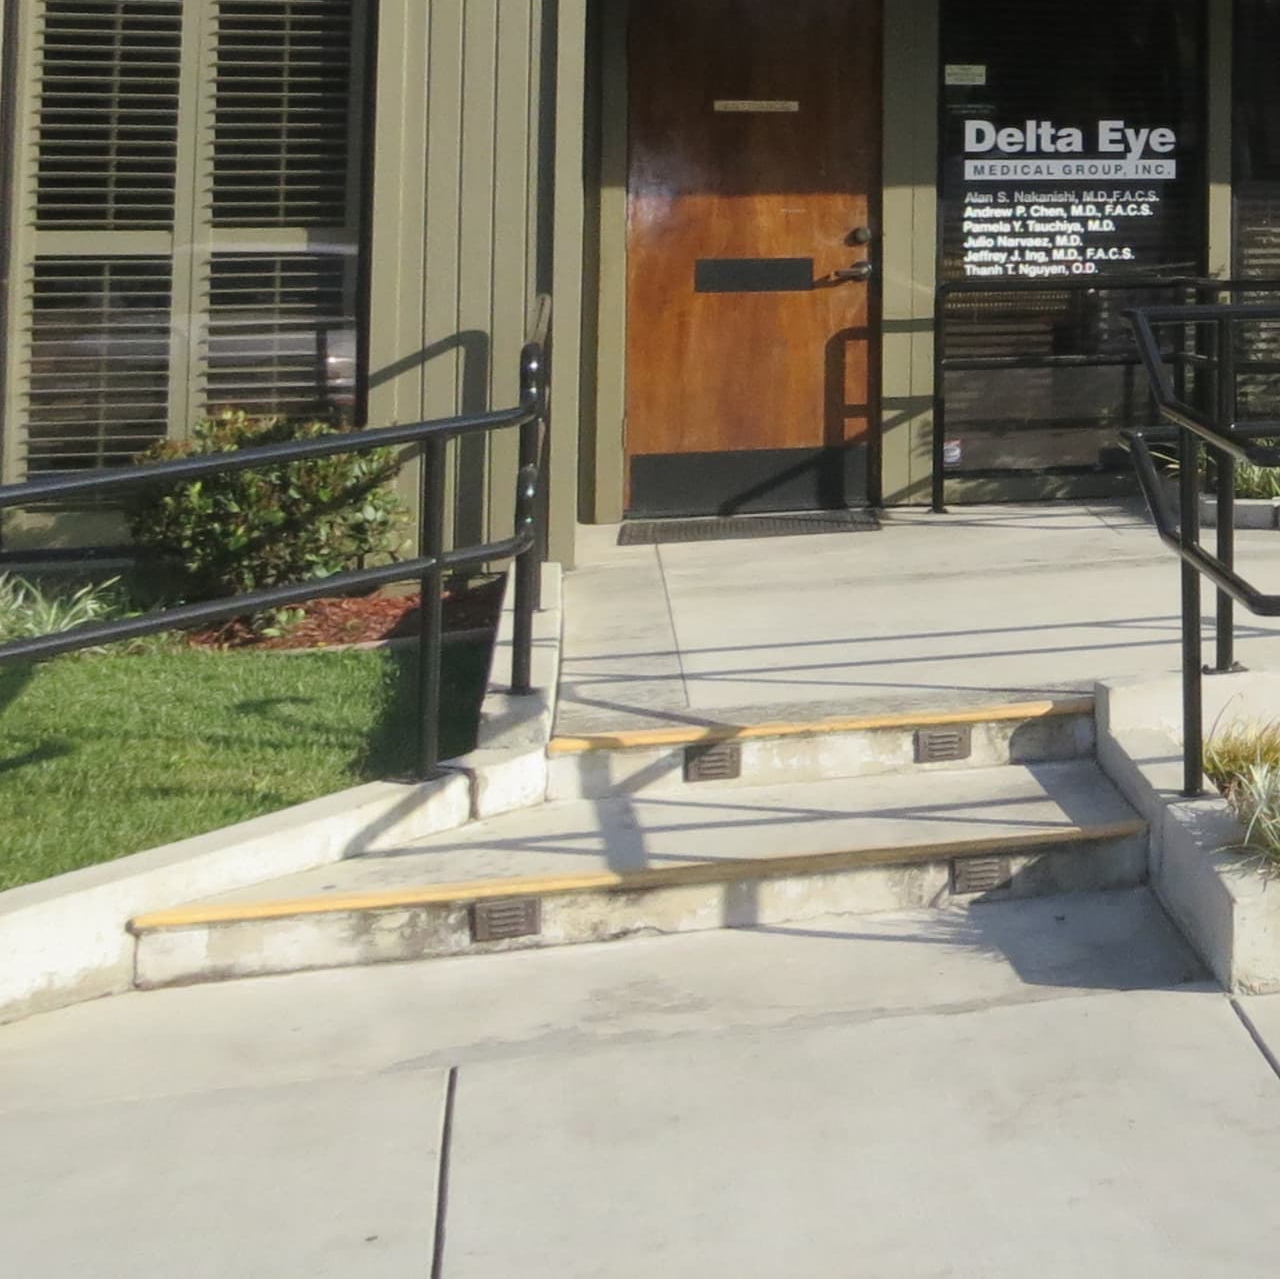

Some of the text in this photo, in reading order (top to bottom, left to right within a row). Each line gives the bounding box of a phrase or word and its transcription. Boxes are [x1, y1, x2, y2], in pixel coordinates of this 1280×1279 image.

[963, 119, 1176, 162] Delta Eye
[972, 164, 1173, 178] MEDICAL GROUP, INC.
[965, 191, 993, 203] Alan
[997, 191, 1010, 203] S.
[1014, 190, 1079, 204] Nakanishi,
[963, 206, 1013, 218] Andrew
[1015, 205, 1028, 217] P.
[1030, 205, 1068, 219] Chen,
[1104, 204, 1154, 216] F.A.C.S.
[963, 220, 1116, 234] Pamela Y. Tsuchiya, M.D.
[963, 235, 1083, 248] Julio Narvaez, M.D.
[963, 250, 1008, 263] Jeffrey
[1009, 250, 1021, 262] J.
[1086, 248, 1136, 260] F.A.C.S.
[963, 262, 1099, 278] Thanh T. Nguyen, O.D.
